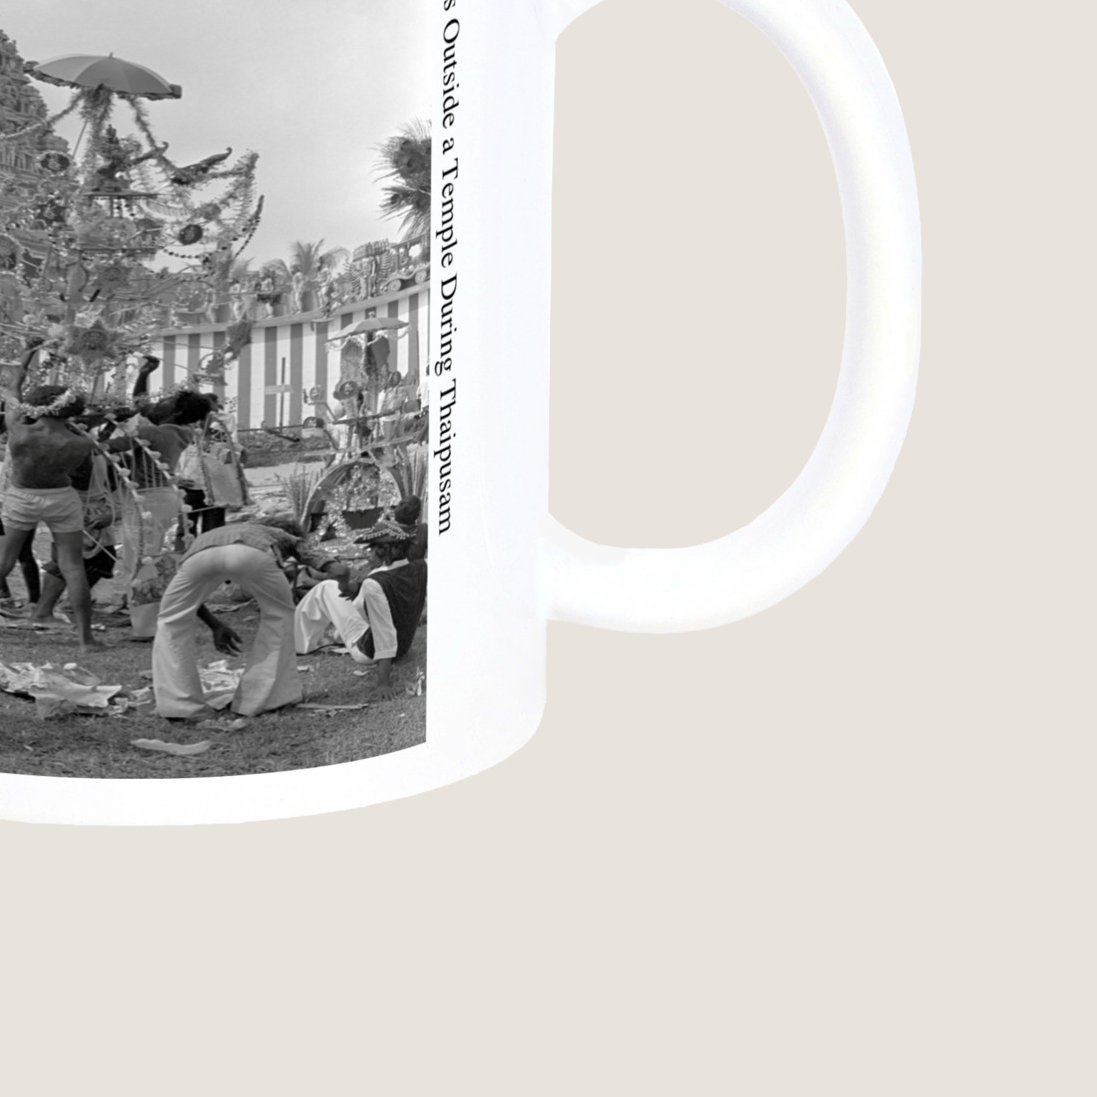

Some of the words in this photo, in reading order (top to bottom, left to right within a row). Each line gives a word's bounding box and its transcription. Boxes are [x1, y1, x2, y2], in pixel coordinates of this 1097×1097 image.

[442, 19, 460, 128] Outside
[443, 138, 454, 155] a
[436, 158, 458, 268] Temple
[435, 273, 457, 376] During
[434, 378, 456, 535] Thaipusam
